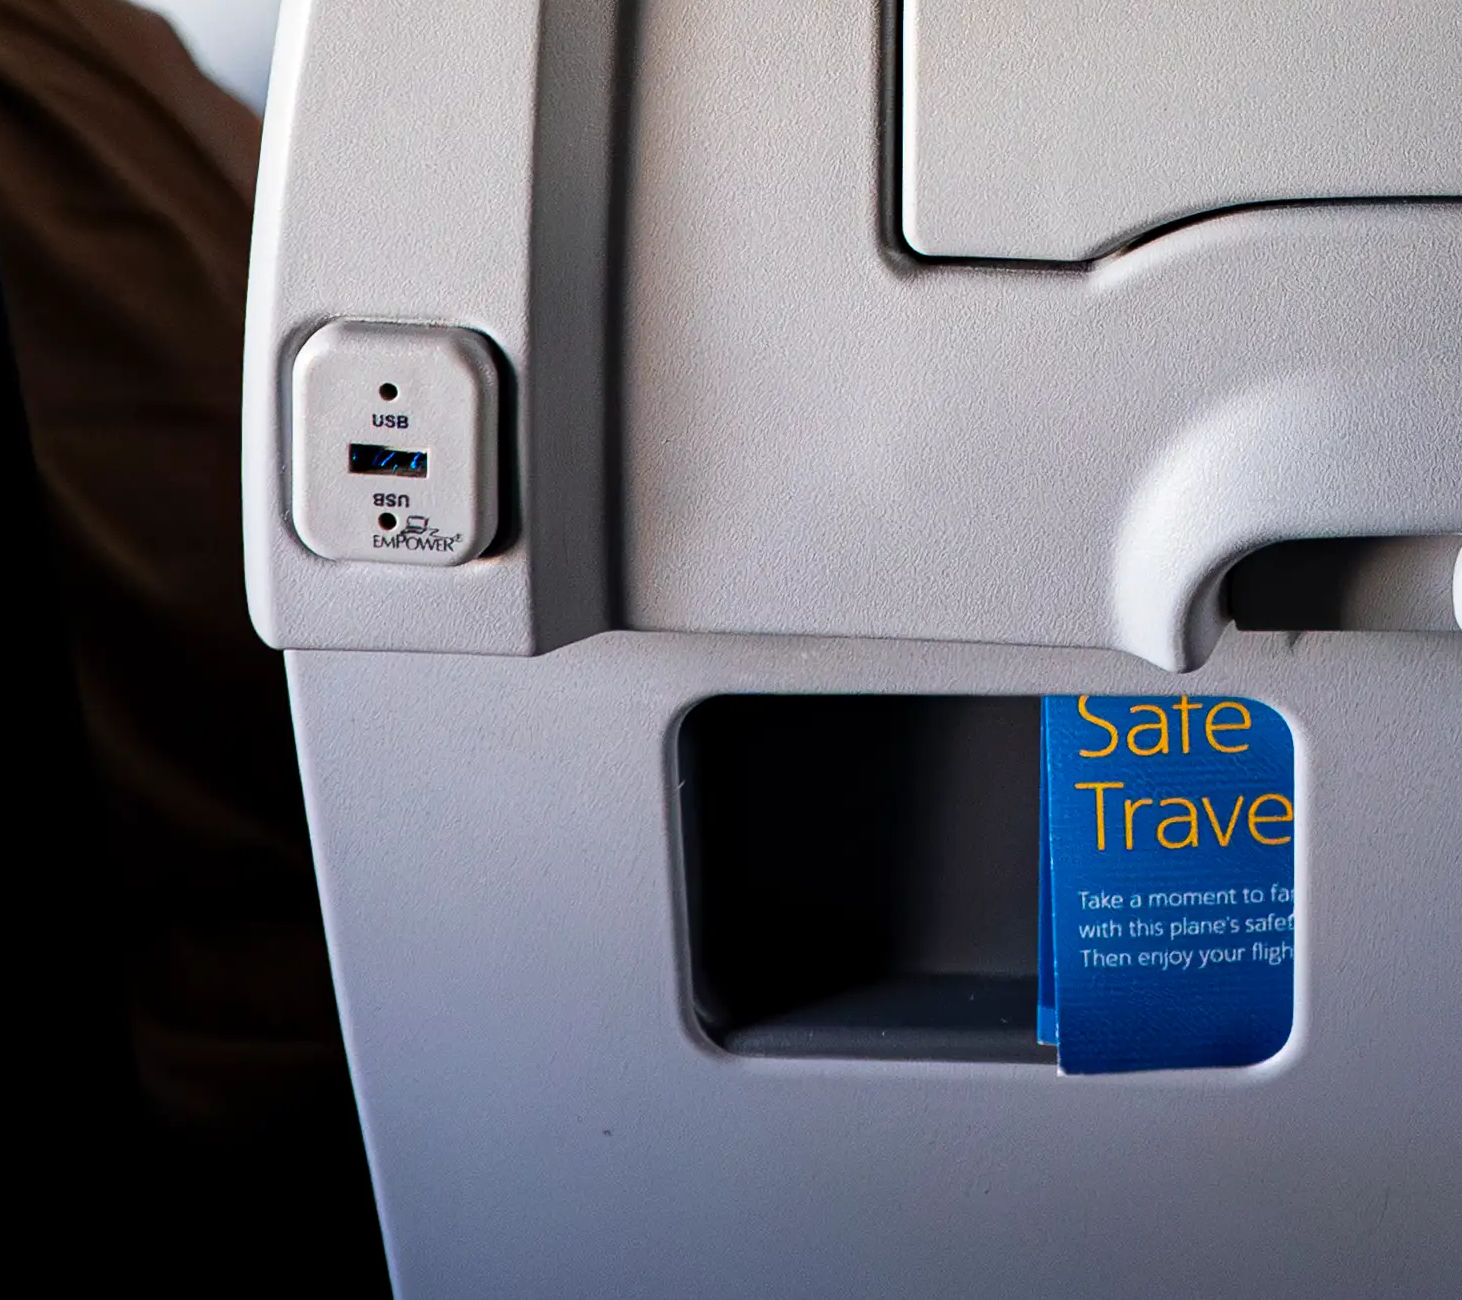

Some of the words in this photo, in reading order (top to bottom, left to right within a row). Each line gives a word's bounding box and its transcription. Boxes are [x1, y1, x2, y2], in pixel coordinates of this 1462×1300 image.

[371, 413, 410, 430] USB
[372, 492, 411, 509] USB
[1073, 781, 1294, 851] Trave
[1079, 889, 1124, 910] Take
[1129, 895, 1142, 909] a
[1147, 888, 1237, 908] moment
[1242, 886, 1264, 905] to
[1270, 881, 1294, 905] fa
[1078, 919, 1123, 939] with
[1128, 918, 1164, 938] this
[1169, 915, 1240, 941] plane's
[1081, 948, 1132, 968] Then
[1137, 949, 1193, 972] enjoy
[1198, 947, 1246, 970] your
